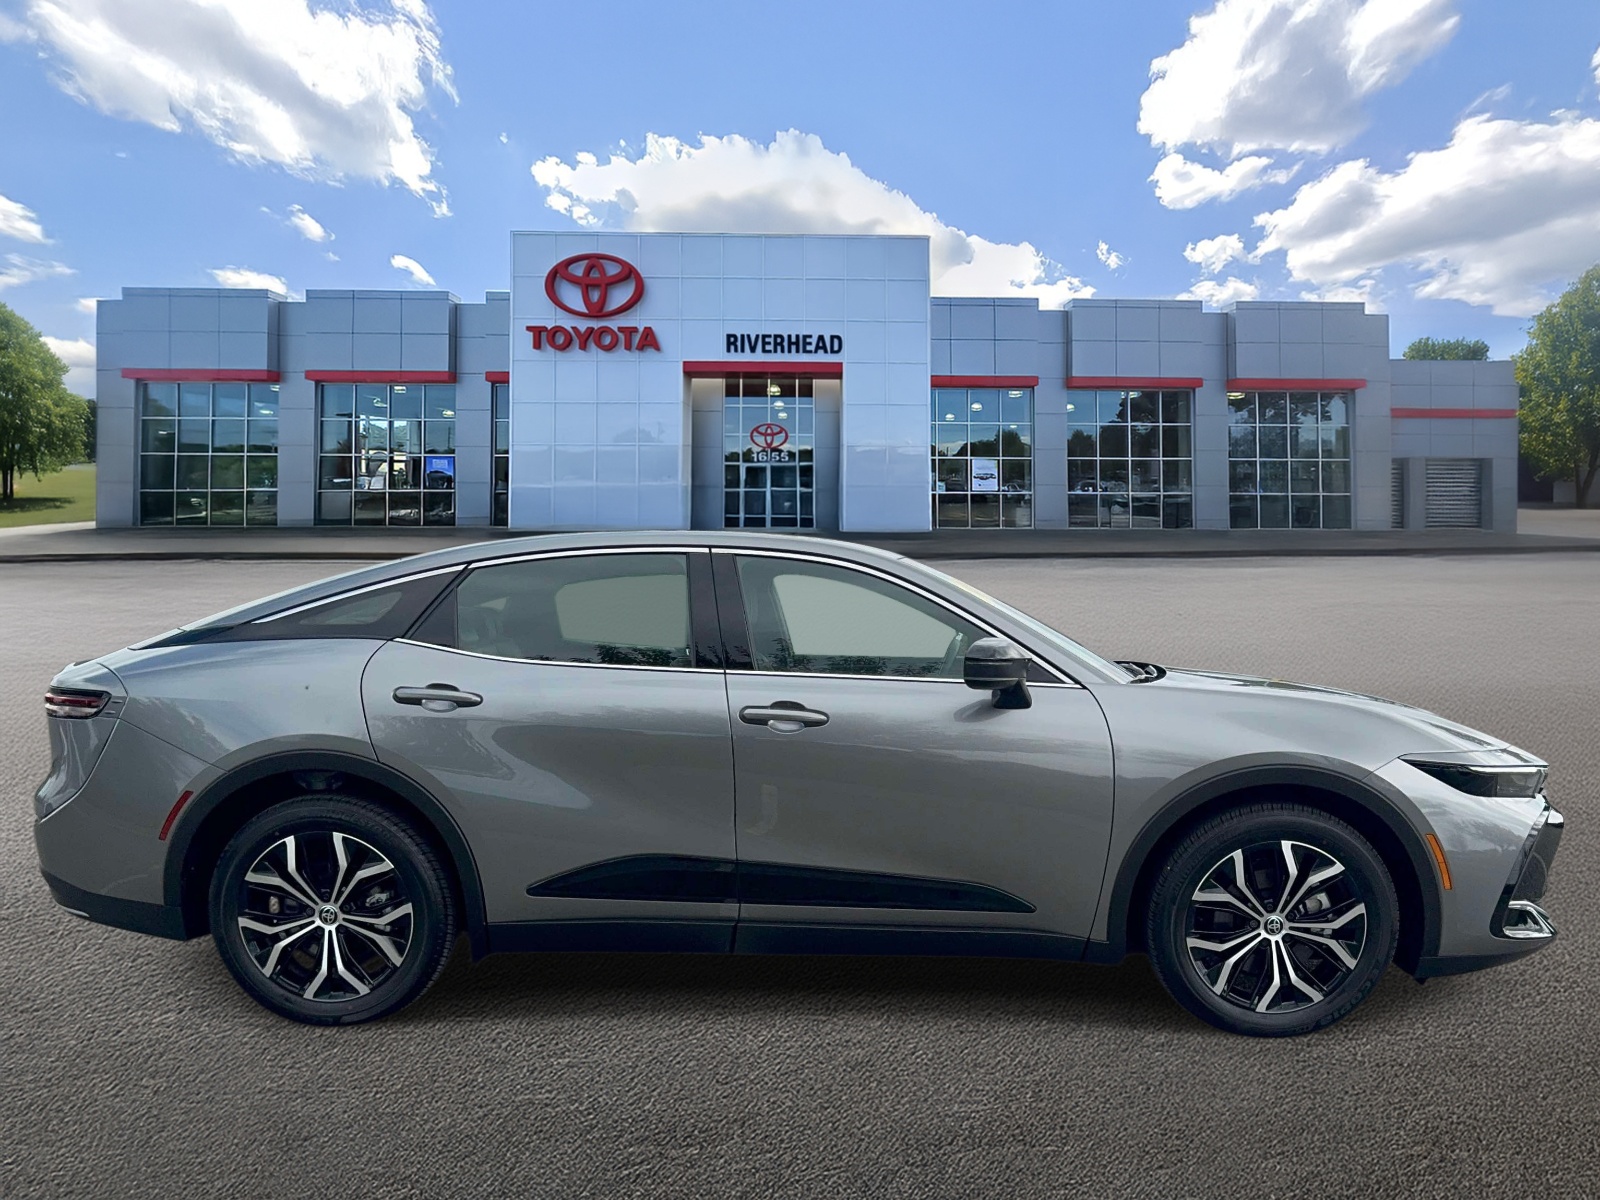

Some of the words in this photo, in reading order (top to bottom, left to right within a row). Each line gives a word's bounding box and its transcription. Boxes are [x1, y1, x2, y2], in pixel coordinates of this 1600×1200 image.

[525, 325, 661, 351] TOYOTA
[726, 333, 843, 354] RIVERHEAD
[752, 451, 789, 462] 1655
